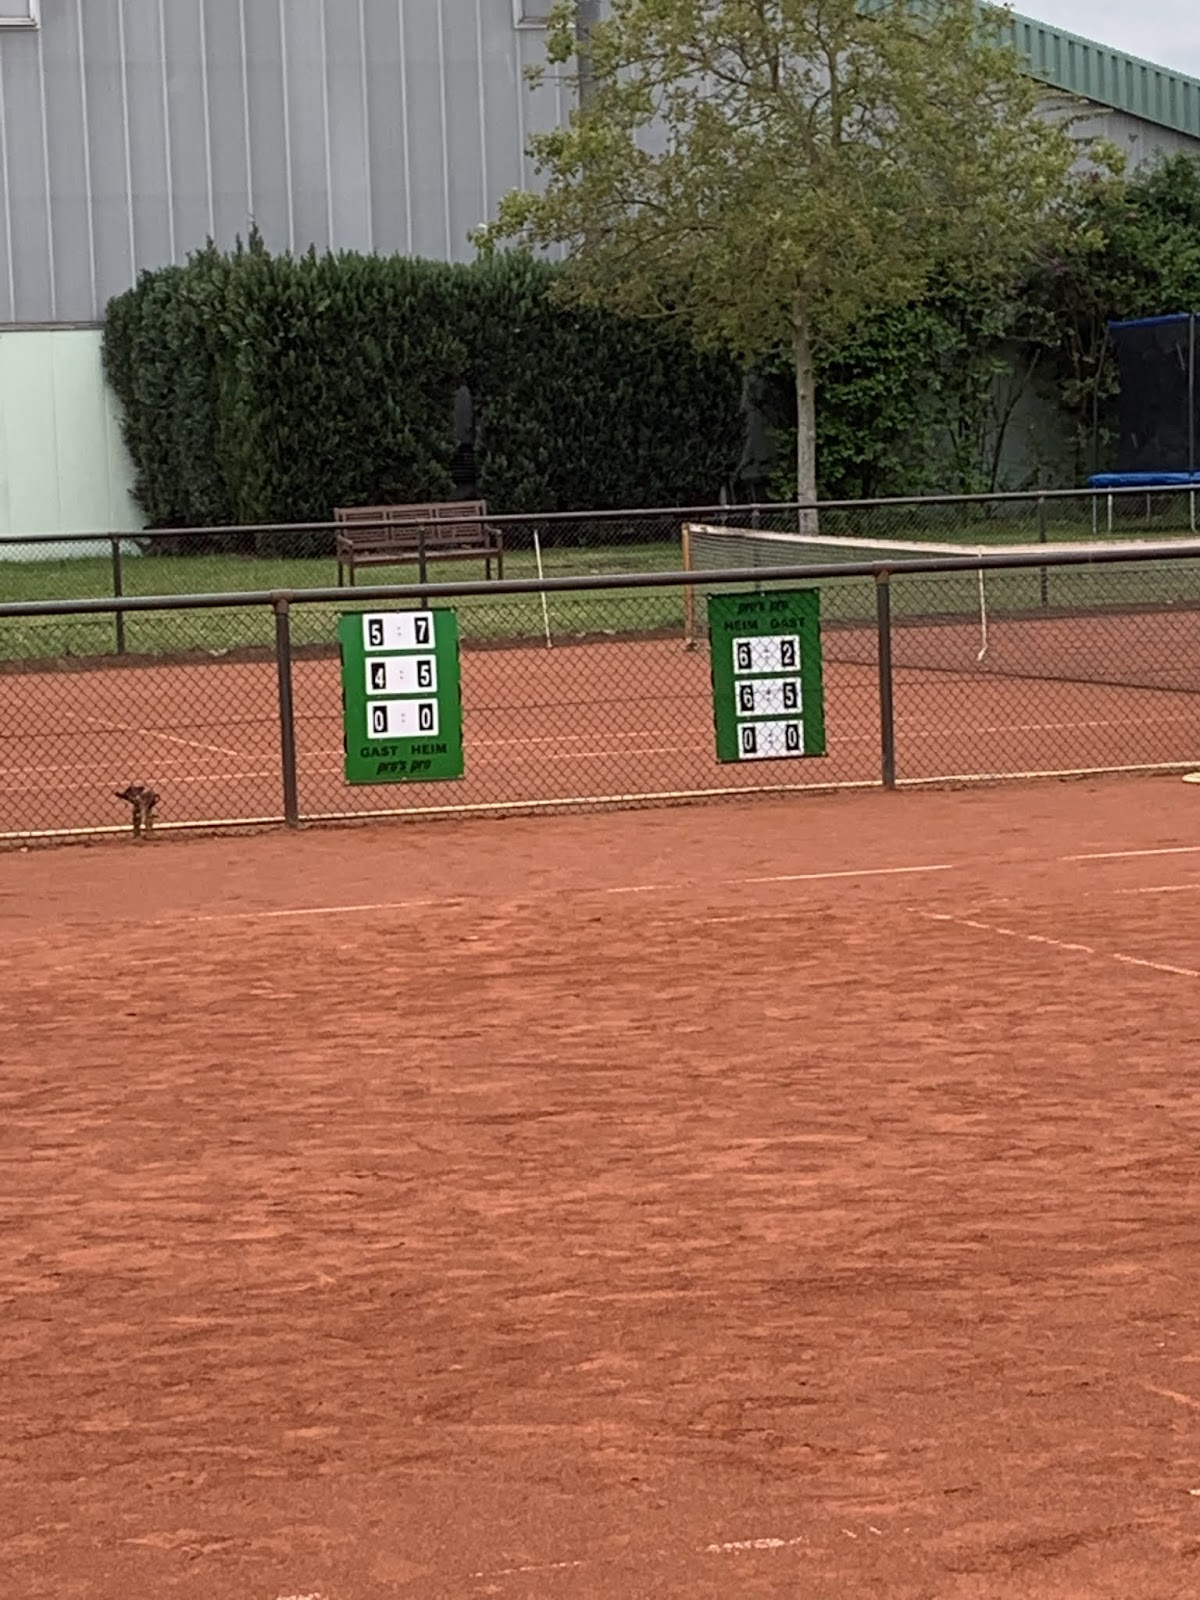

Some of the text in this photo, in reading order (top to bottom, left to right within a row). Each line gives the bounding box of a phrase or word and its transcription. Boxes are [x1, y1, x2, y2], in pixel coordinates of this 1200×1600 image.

[371, 623, 382, 645] 5
[416, 620, 427, 642] 7
[738, 645, 749, 667] 6
[782, 643, 793, 664] 2
[374, 668, 385, 688] 4
[419, 664, 430, 686] 5
[742, 687, 753, 708] 6
[784, 685, 795, 706] 5
[374, 711, 384, 732] 0
[421, 707, 431, 729] 0
[744, 730, 753, 750] 0
[787, 727, 797, 748] 0
[360, 743, 447, 758] GAST HEIM
[410, 759, 432, 773] pro
